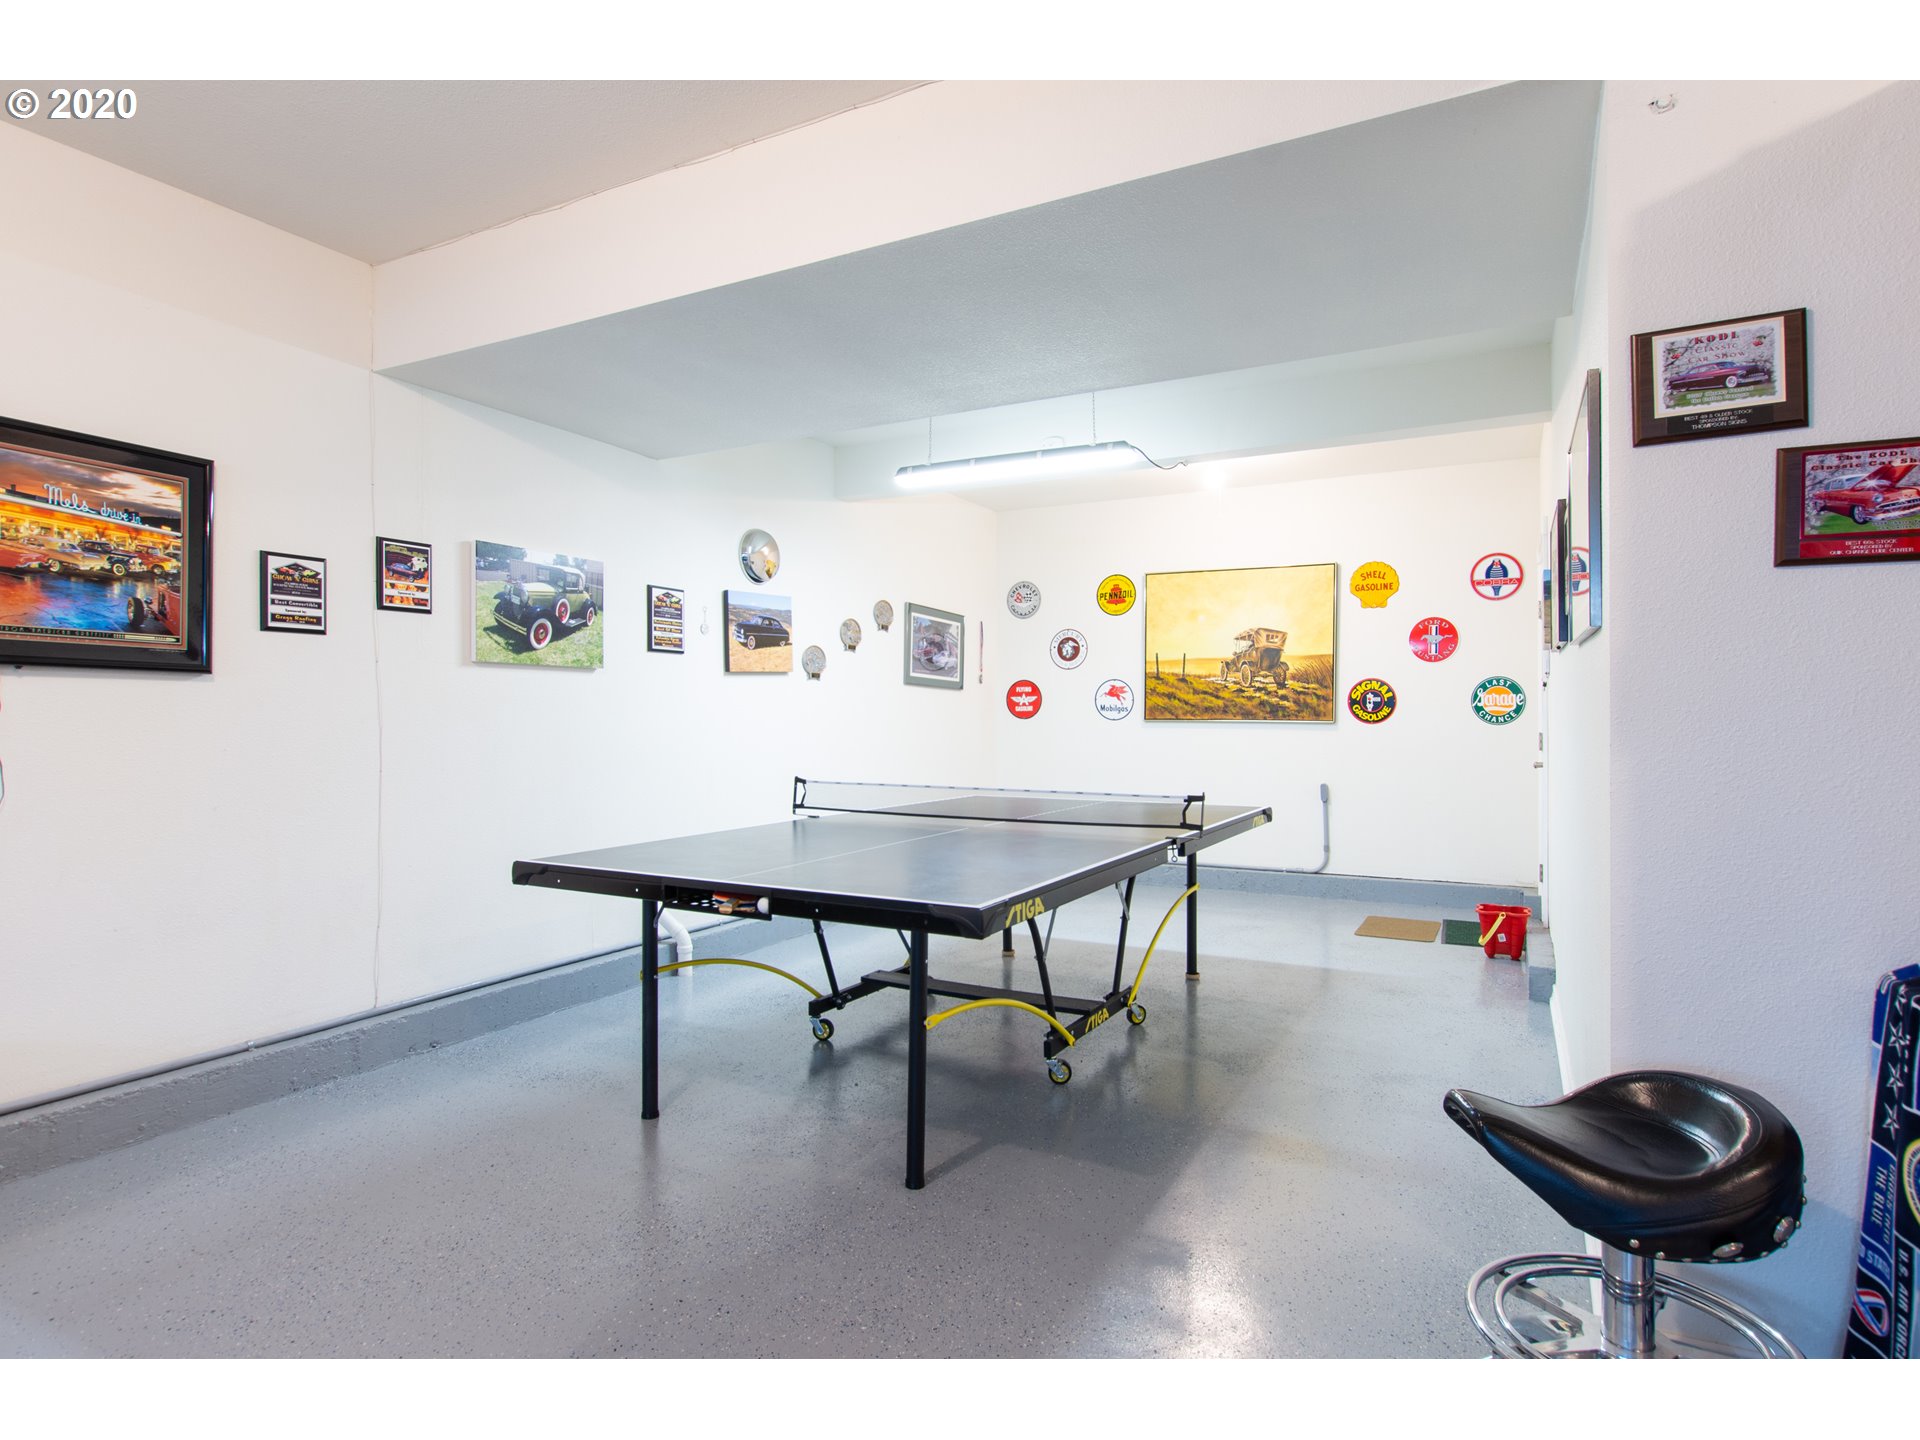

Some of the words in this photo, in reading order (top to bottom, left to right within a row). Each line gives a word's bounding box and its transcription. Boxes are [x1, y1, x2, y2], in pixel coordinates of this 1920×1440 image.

[1694, 331, 1740, 344] KODL
[1692, 421, 1727, 430] THOMPSON
[1869, 450, 1908, 458] KODL
[1810, 463, 1862, 471] Classic
[43, 483, 97, 514] Mels
[100, 501, 143, 525] drive-in
[1360, 570, 1386, 581] SHELL
[1475, 578, 1519, 586] COBRA
[1010, 583, 1038, 598] CHEVROLET
[1355, 582, 1394, 592] GASOLINE
[1099, 590, 1133, 601] PENNZOIL
[288, 600, 319, 608] Convertible
[1418, 619, 1449, 629] FORD
[1485, 679, 1512, 687] LAST
[1351, 680, 1393, 701] SIGNAL
[1472, 687, 1524, 711] Garage
[1100, 704, 1129, 714] Mobilgas
[1352, 704, 1392, 722] GASOLINE
[1479, 710, 1517, 723] CHANCE
[1005, 896, 1045, 928] STIGA
[1085, 1007, 1109, 1033] STIGA
[1874, 1164, 1889, 1188] THE
[1869, 1191, 1886, 1228] BLUE
[1897, 1247, 1909, 1277] U.S.
[1897, 1280, 1909, 1313] AIR
